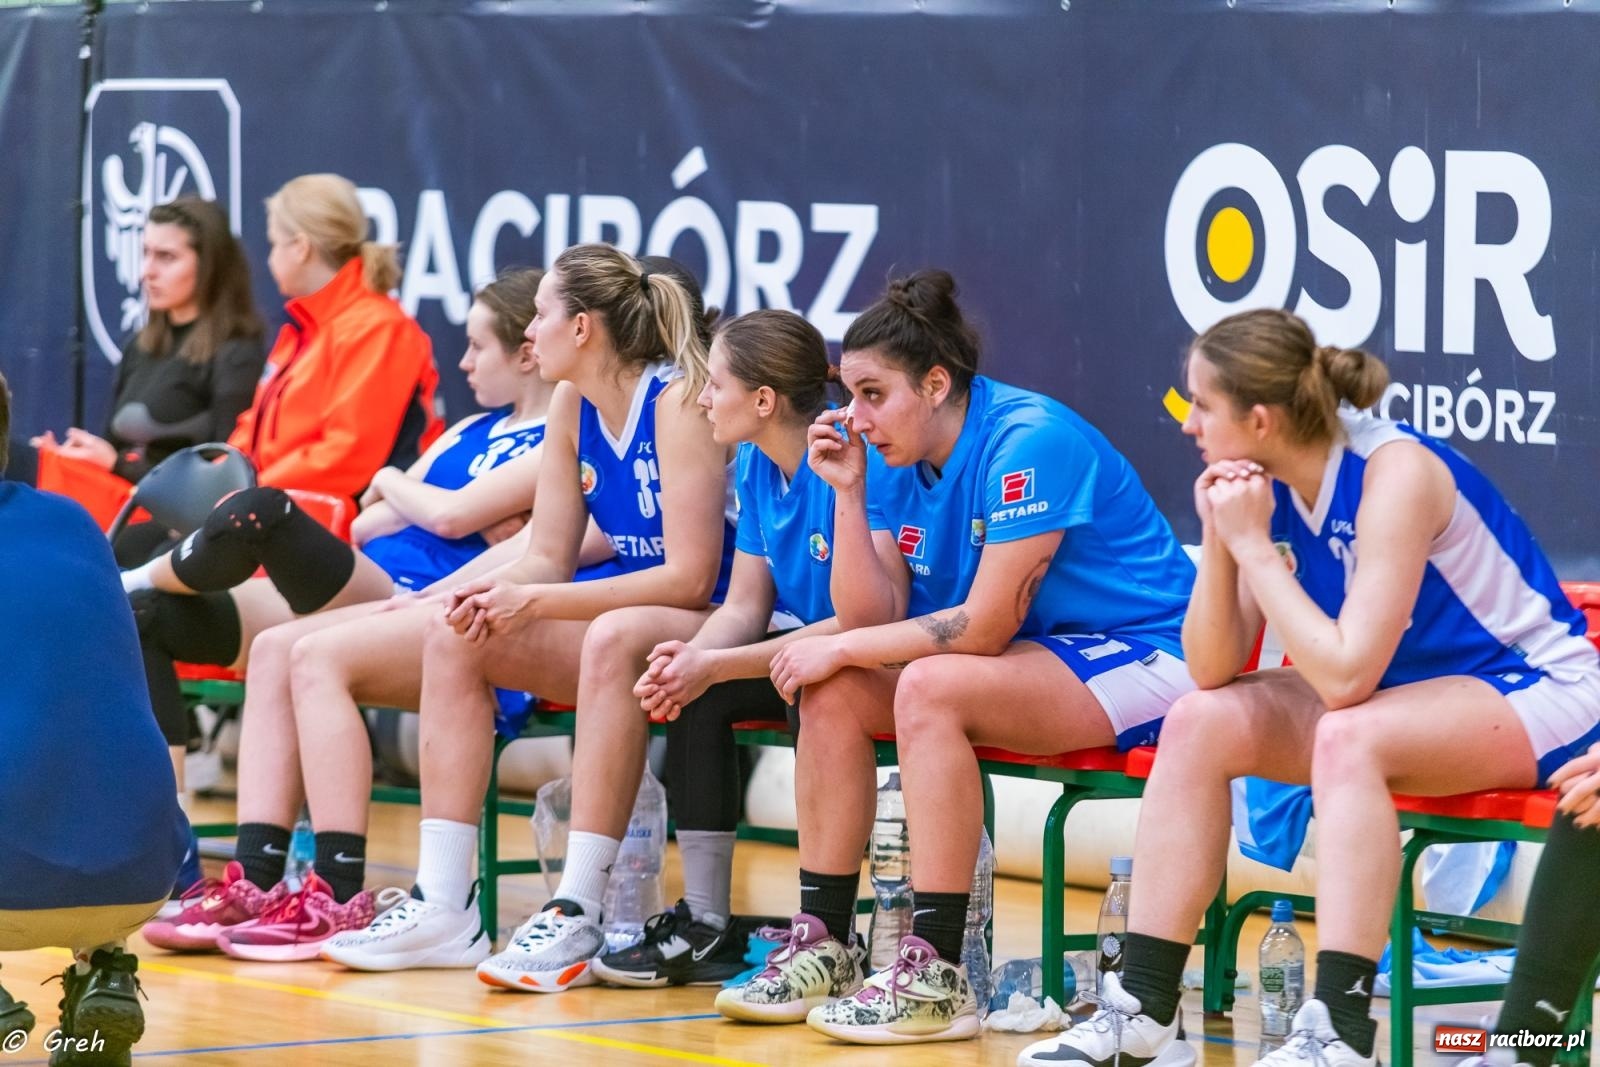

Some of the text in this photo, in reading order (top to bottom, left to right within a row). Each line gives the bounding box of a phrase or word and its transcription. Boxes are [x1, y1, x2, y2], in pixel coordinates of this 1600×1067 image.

[1366, 367, 1557, 446] CIBÓRZ
[991, 500, 1049, 523] BETARD
[603, 531, 664, 558] ETAR
